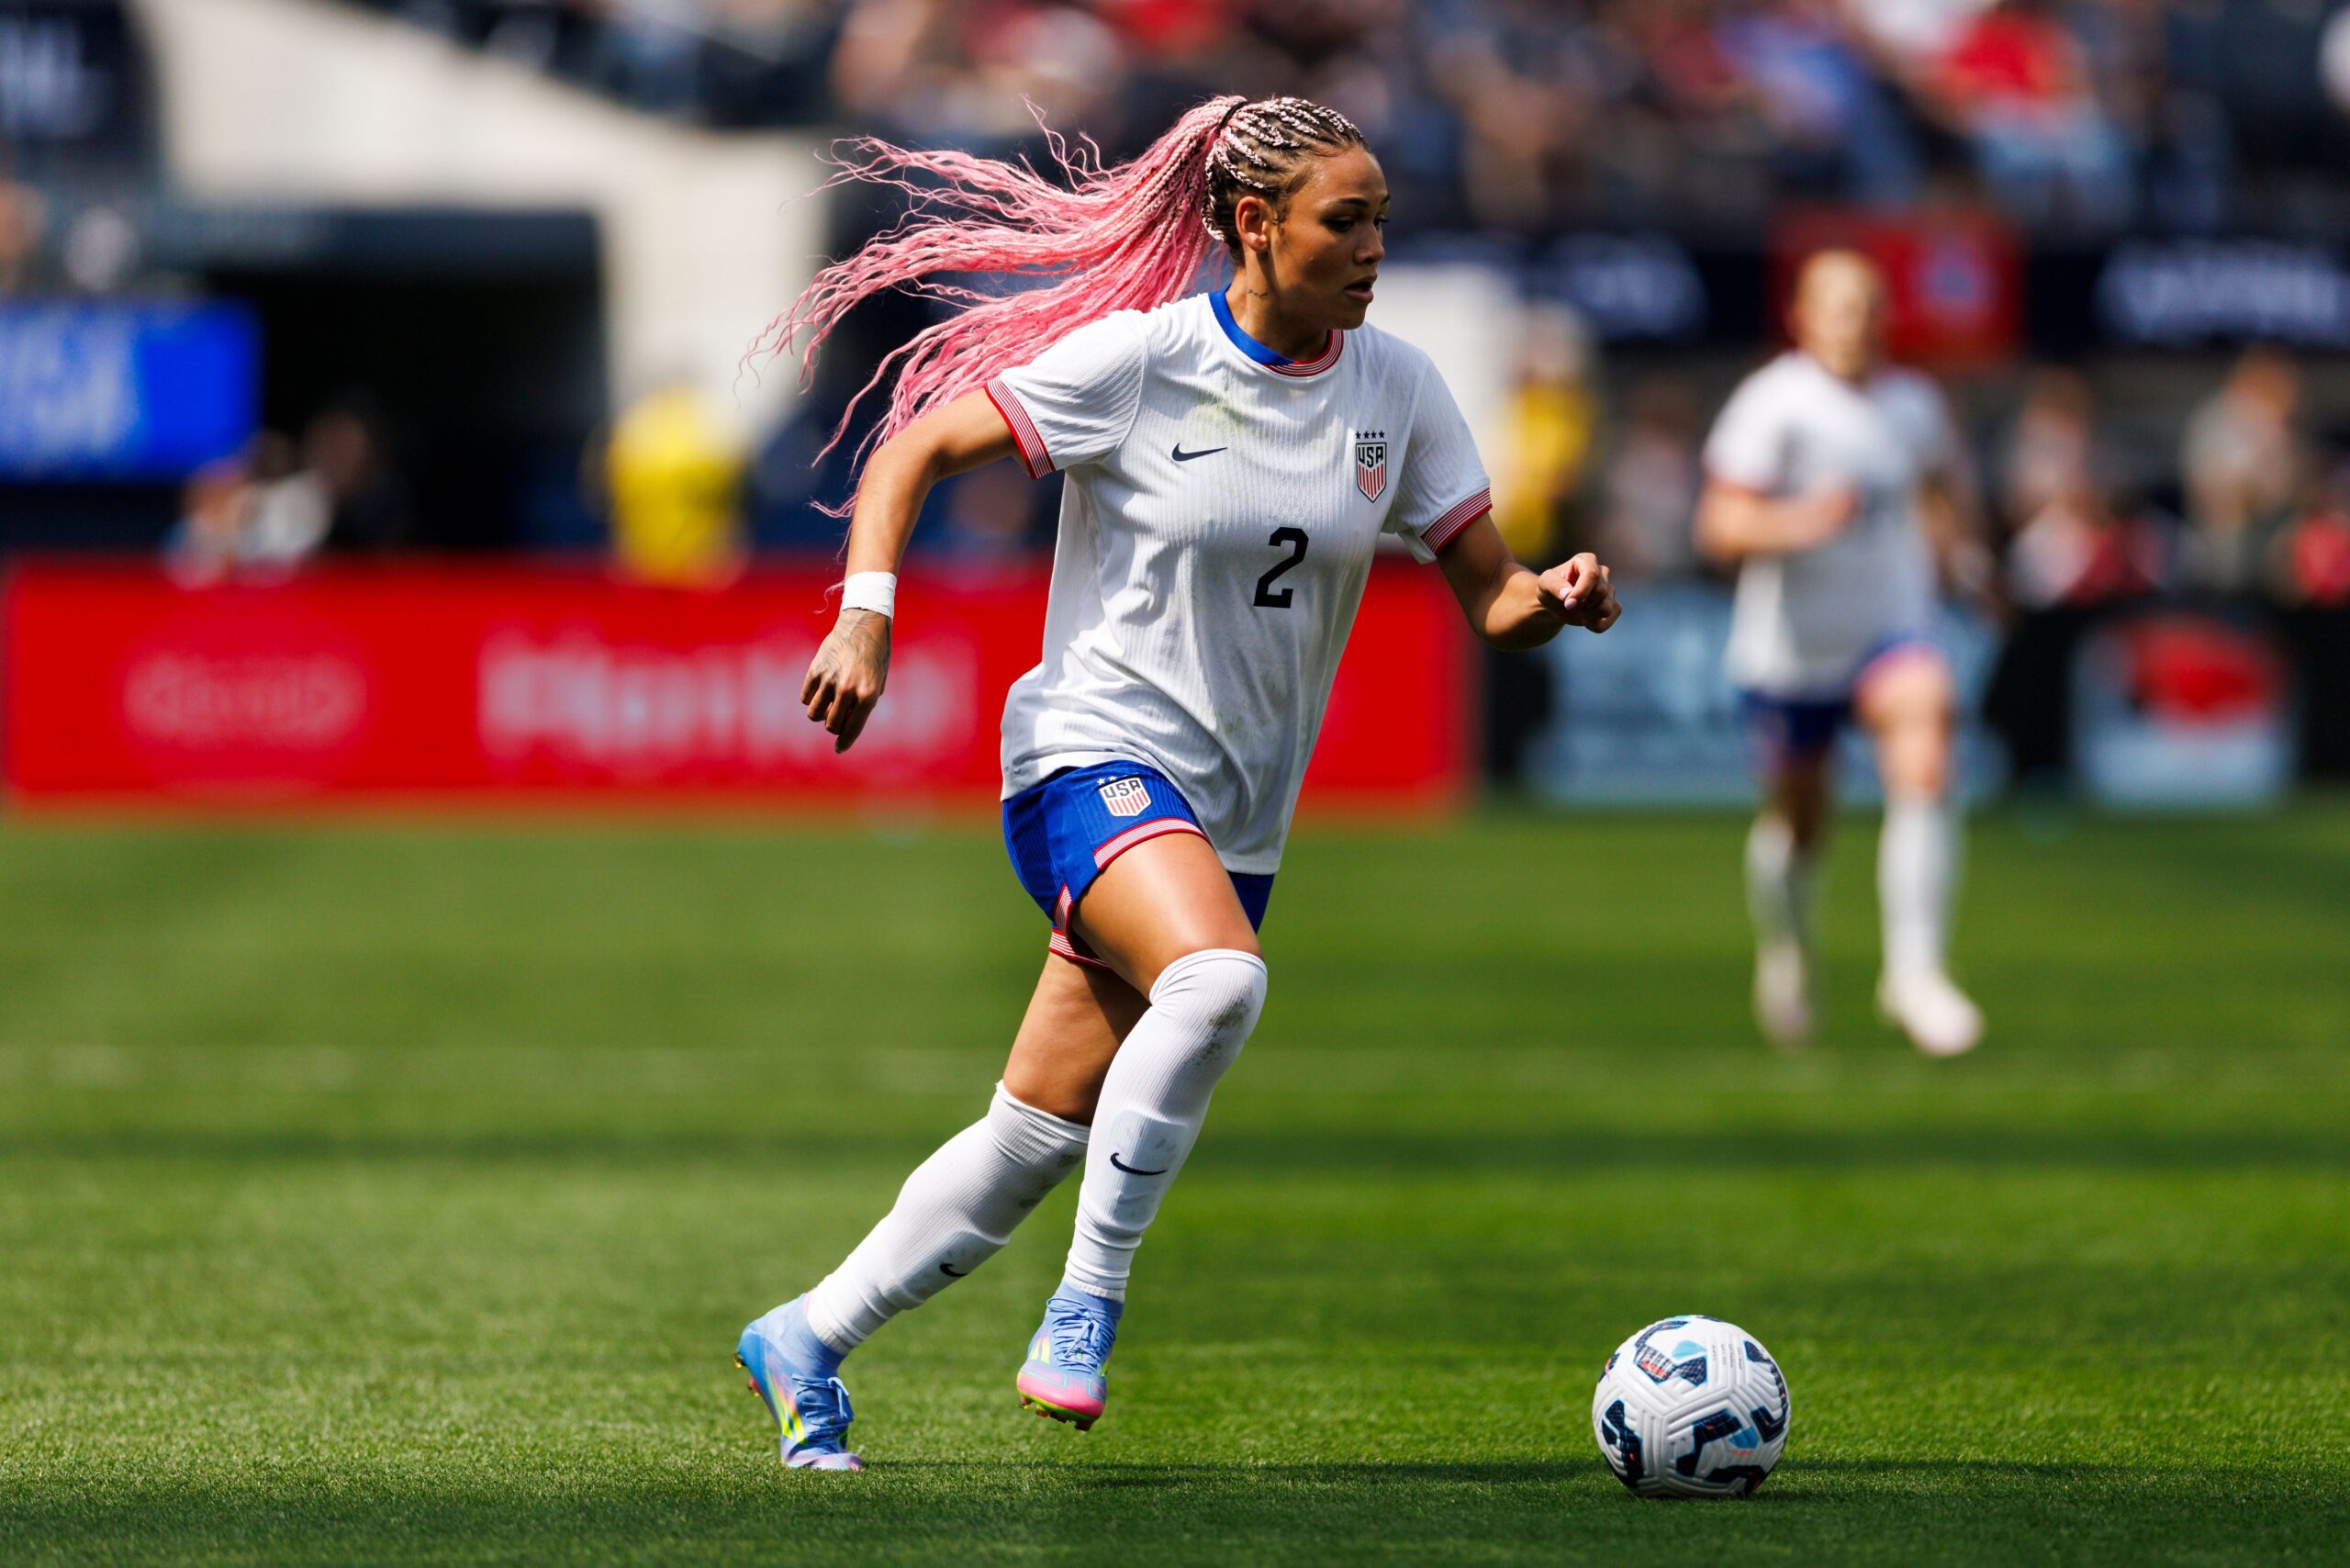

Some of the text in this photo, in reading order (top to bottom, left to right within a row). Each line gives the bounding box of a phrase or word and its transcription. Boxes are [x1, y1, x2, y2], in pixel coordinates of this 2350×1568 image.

[1358, 445, 1384, 468] USA
[1253, 526, 1309, 609] 2
[1103, 779, 1141, 799] USA
